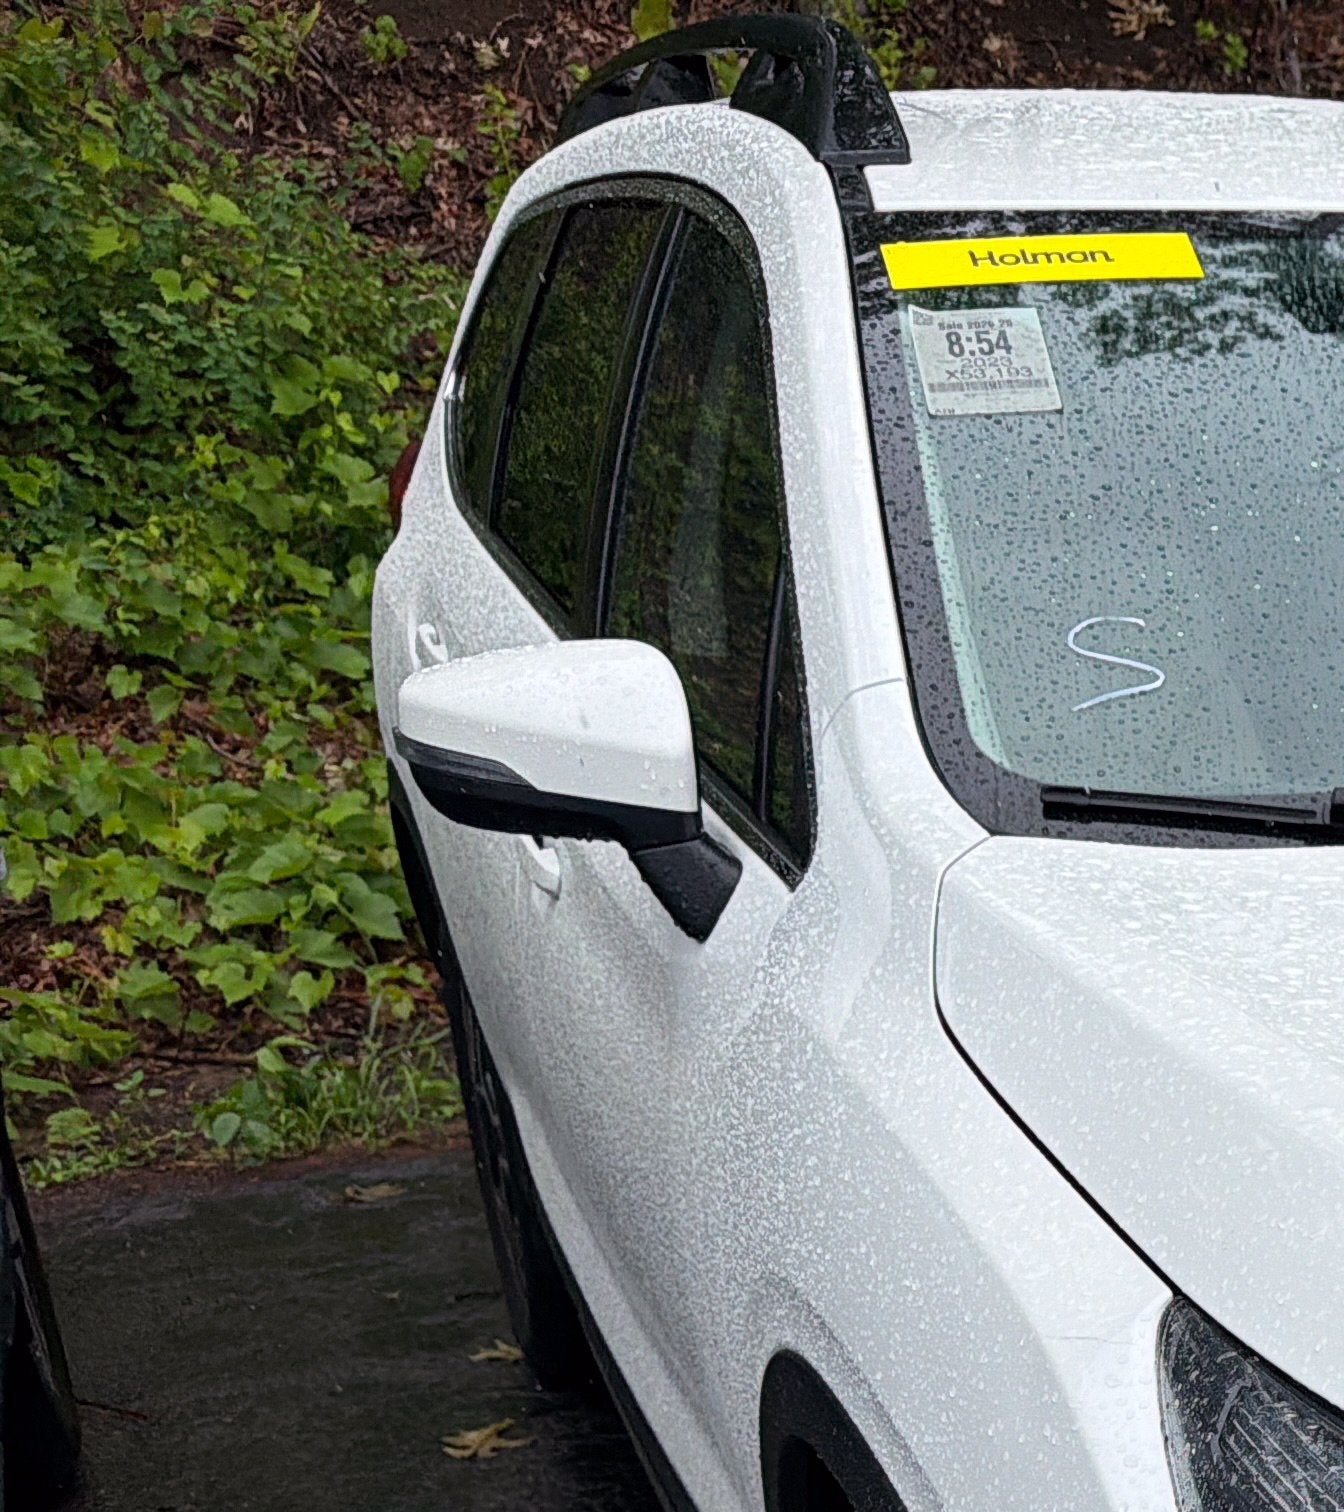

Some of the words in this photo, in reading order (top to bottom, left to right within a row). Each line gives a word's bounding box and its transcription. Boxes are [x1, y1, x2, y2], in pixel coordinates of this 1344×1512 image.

[968, 248, 1115, 267] Holman
[945, 330, 1012, 357] 8:54
[961, 356, 1013, 369] 2023
[1067, 616, 1165, 711] S
